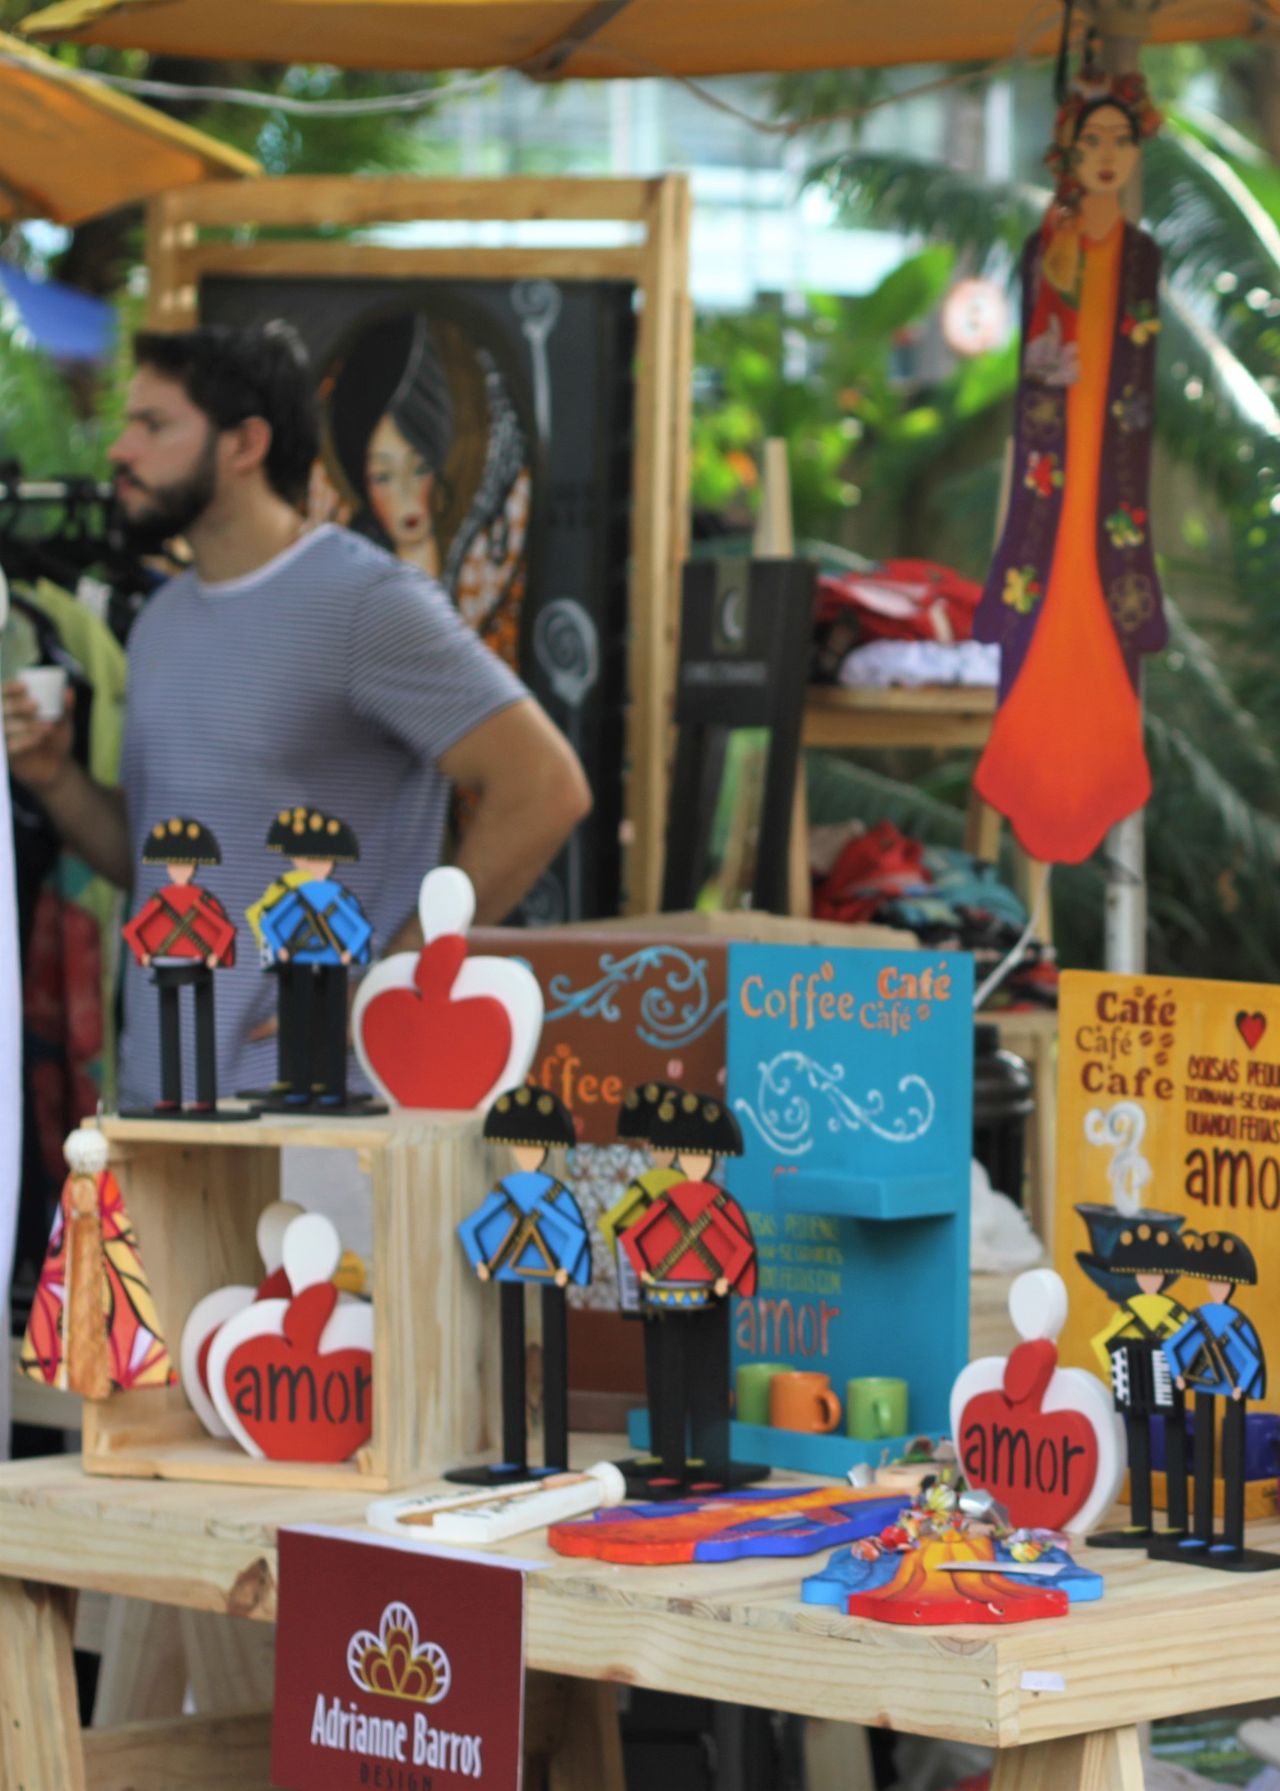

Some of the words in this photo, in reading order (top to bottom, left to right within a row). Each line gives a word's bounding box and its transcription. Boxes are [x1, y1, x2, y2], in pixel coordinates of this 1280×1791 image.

[740, 972, 855, 1031] Coffee
[877, 961, 951, 1000] Café
[1096, 988, 1177, 1028] Café
[735, 1298, 841, 1357] amor
[233, 1362, 372, 1424] amor
[964, 1422, 1086, 1496] amor
[310, 1692, 407, 1763] Adrianne
[412, 1711, 482, 1779] Barros
